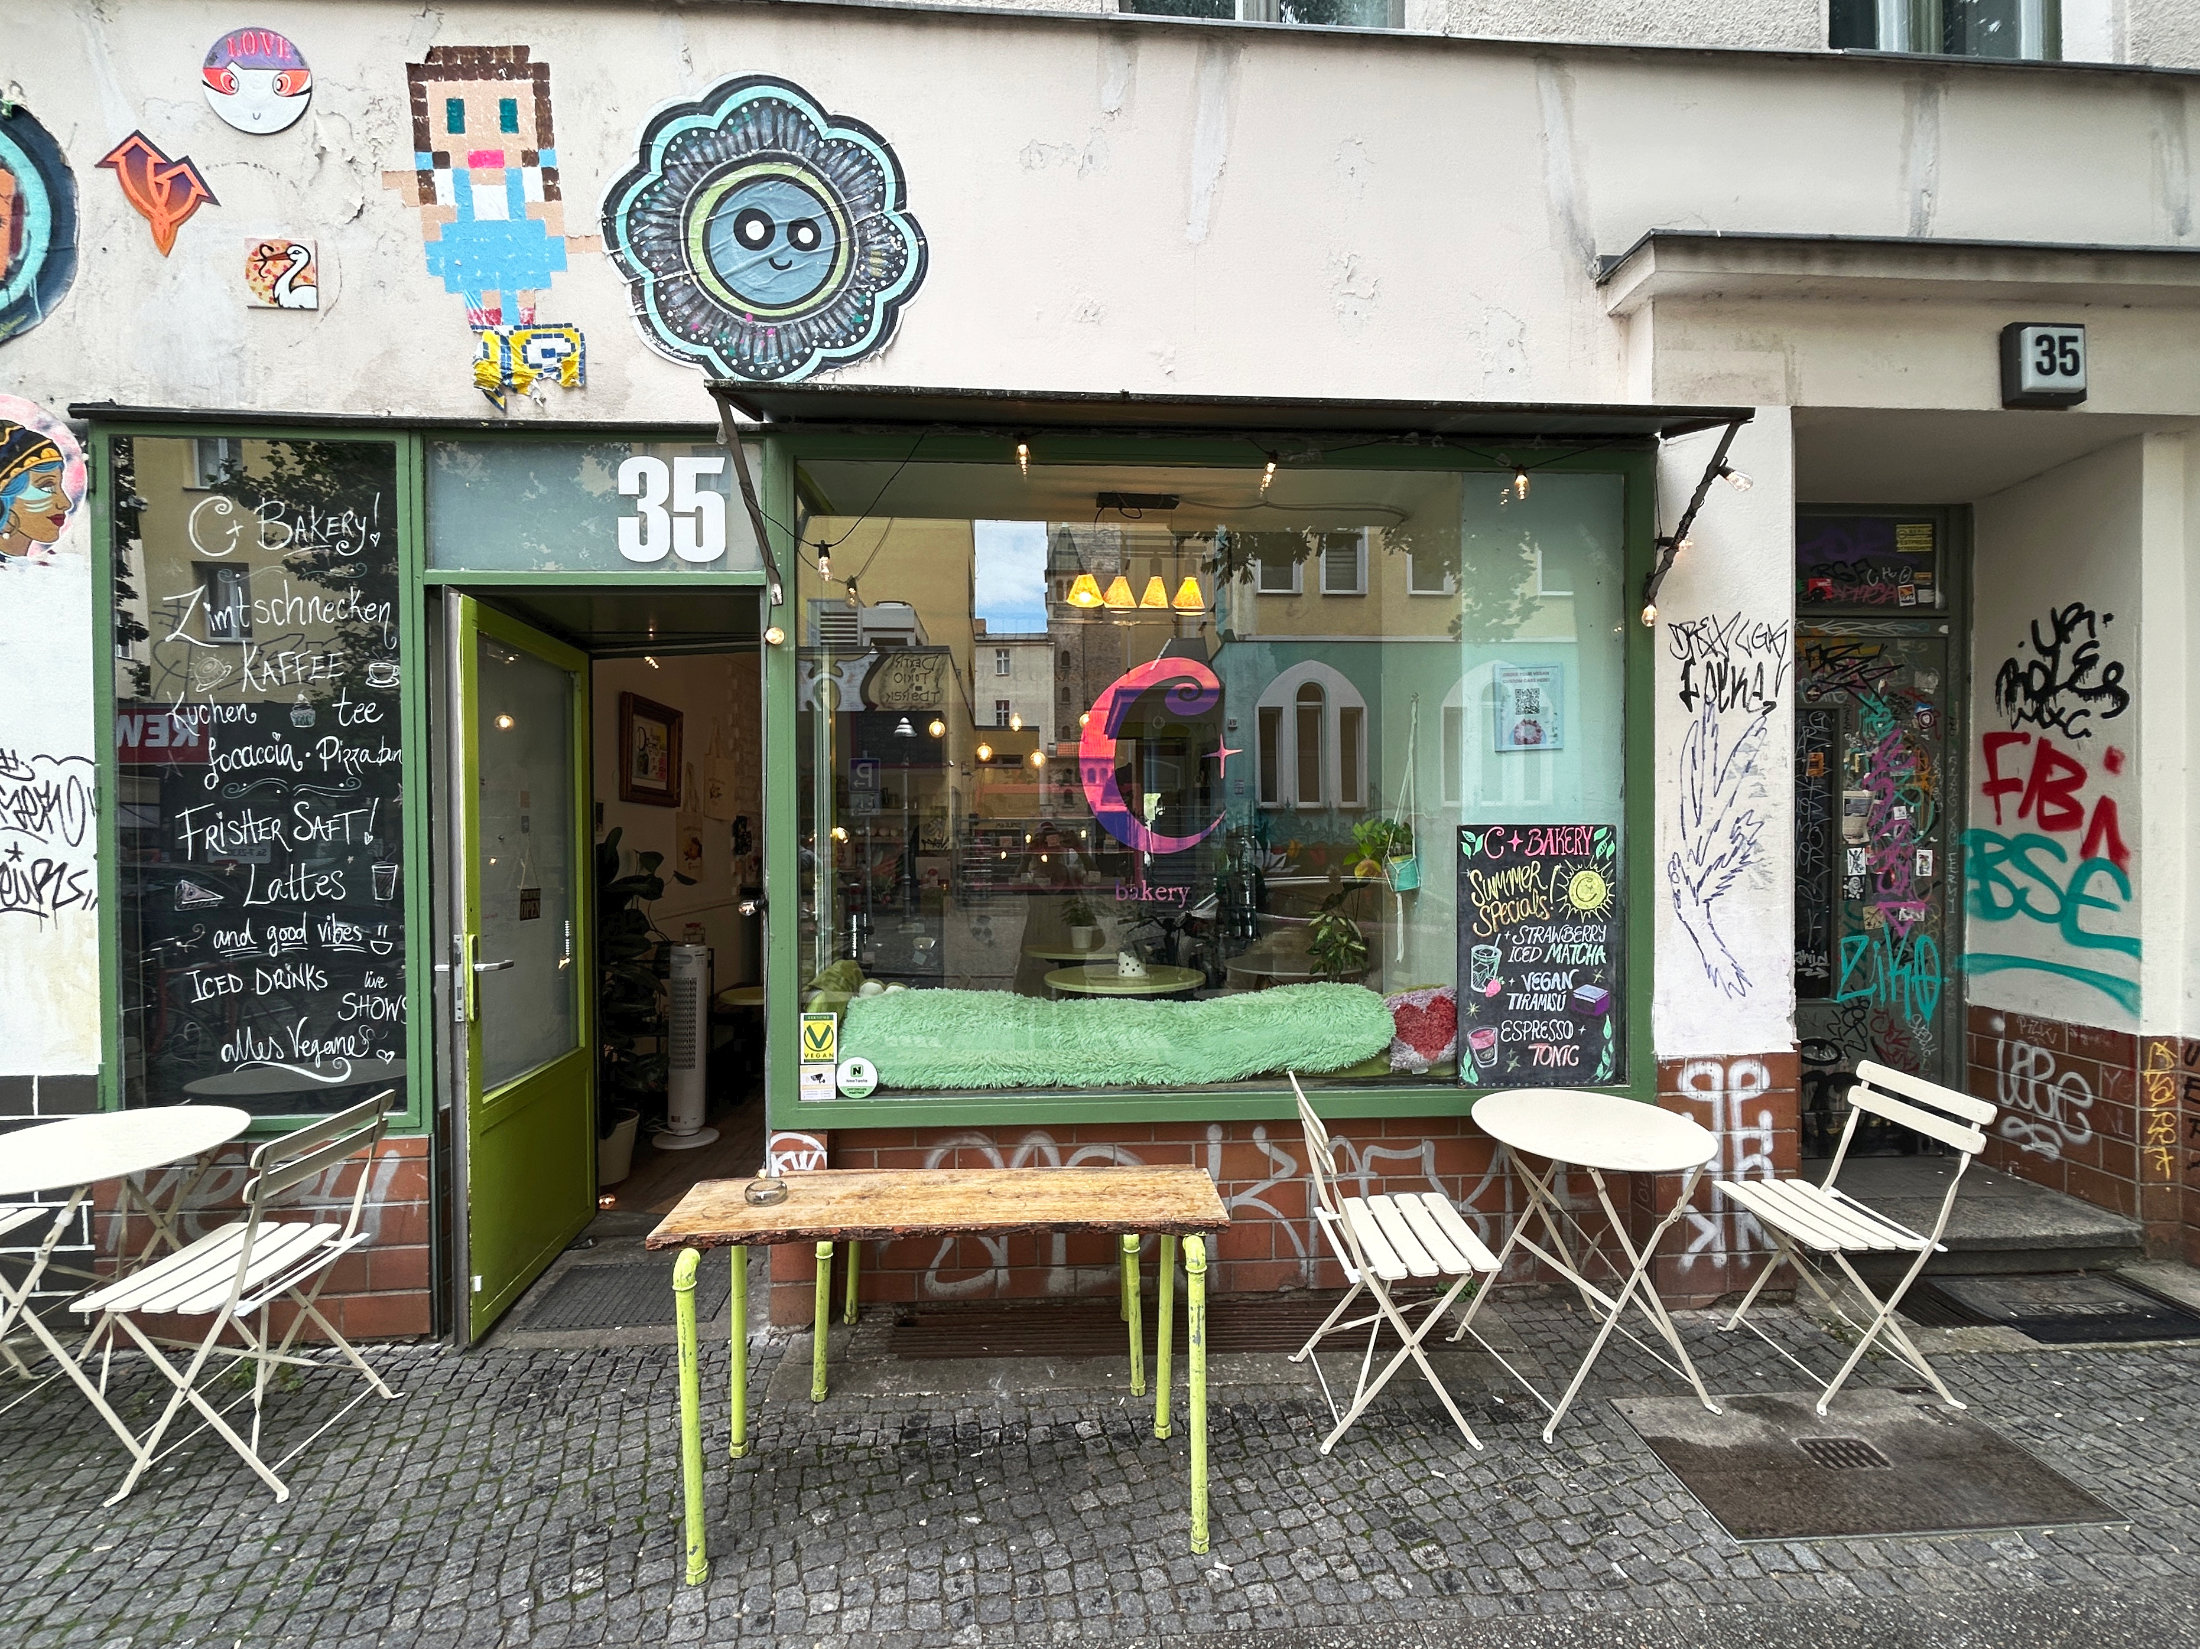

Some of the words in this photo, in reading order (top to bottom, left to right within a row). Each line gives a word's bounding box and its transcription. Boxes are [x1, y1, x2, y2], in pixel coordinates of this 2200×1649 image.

[226, 29, 292, 59] LOVE
[2035, 334, 2080, 377] 35
[617, 455, 727, 563] 35
[162, 579, 397, 650] Zimtschnecken
[242, 640, 344, 693] KAFFEE
[165, 690, 257, 737] Kuchen
[1524, 826, 1594, 857] BAKERY
[243, 862, 347, 907] Lattes
[1115, 880, 1191, 908] bakery
[213, 917, 257, 949] and
[266, 911, 308, 957] good
[317, 912, 363, 943] vibes
[1512, 925, 1607, 945] STRAWBERRY
[1507, 946, 1543, 963] ICED
[1543, 943, 1607, 966] MATCHA
[185, 970, 243, 1004] ICED
[364, 970, 388, 989] live
[1521, 969, 1580, 992] VEGAN
[1500, 1019, 1574, 1042] ESPRESSO
[1528, 1043, 1580, 1067] TONIC
